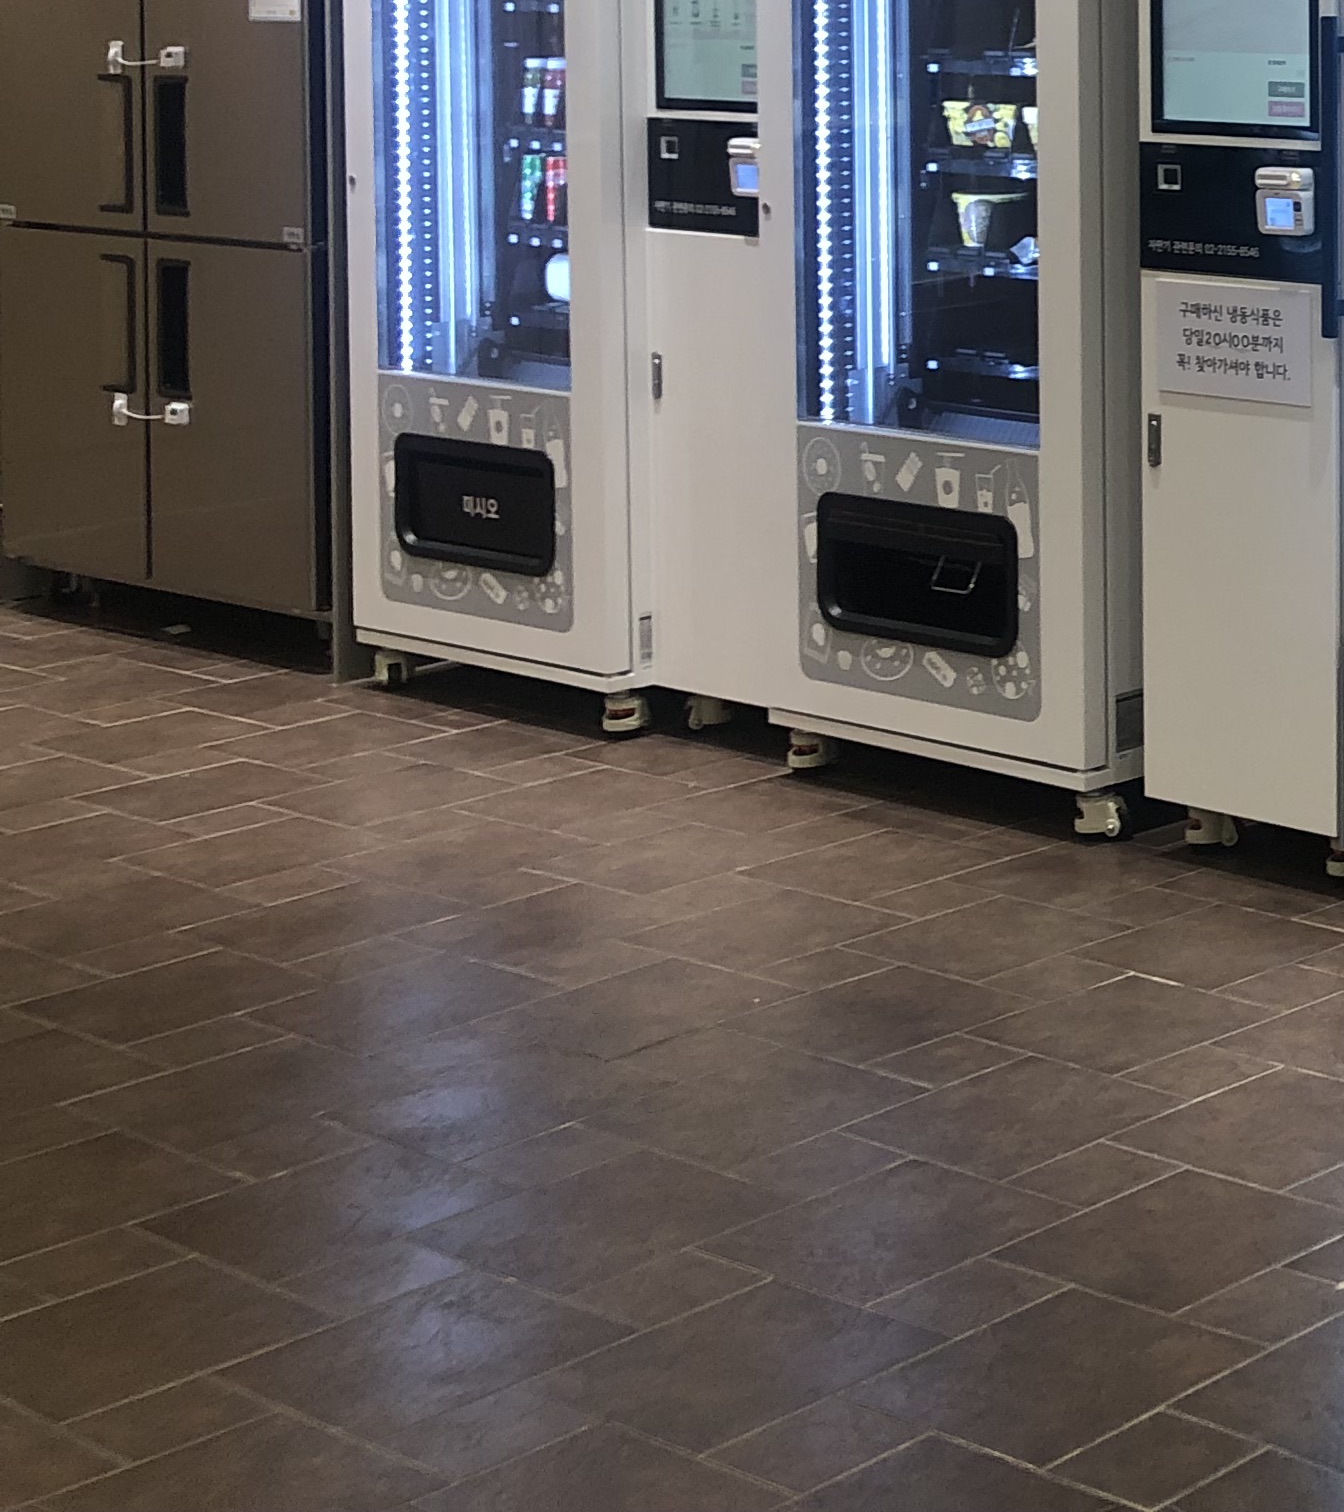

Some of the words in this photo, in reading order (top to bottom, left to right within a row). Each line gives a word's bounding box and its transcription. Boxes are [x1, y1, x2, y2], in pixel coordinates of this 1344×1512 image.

[1179, 301, 1223, 322] 구매하신
[1226, 306, 1283, 327] 냉동식품은
[1183, 328, 1284, 354] 당일20시00분까지
[1177, 353, 1192, 371] 꼭!
[1195, 355, 1251, 376] 찾아가셔야
[1253, 361, 1291, 381] 합니다.
[462, 495, 501, 519] 미시오
